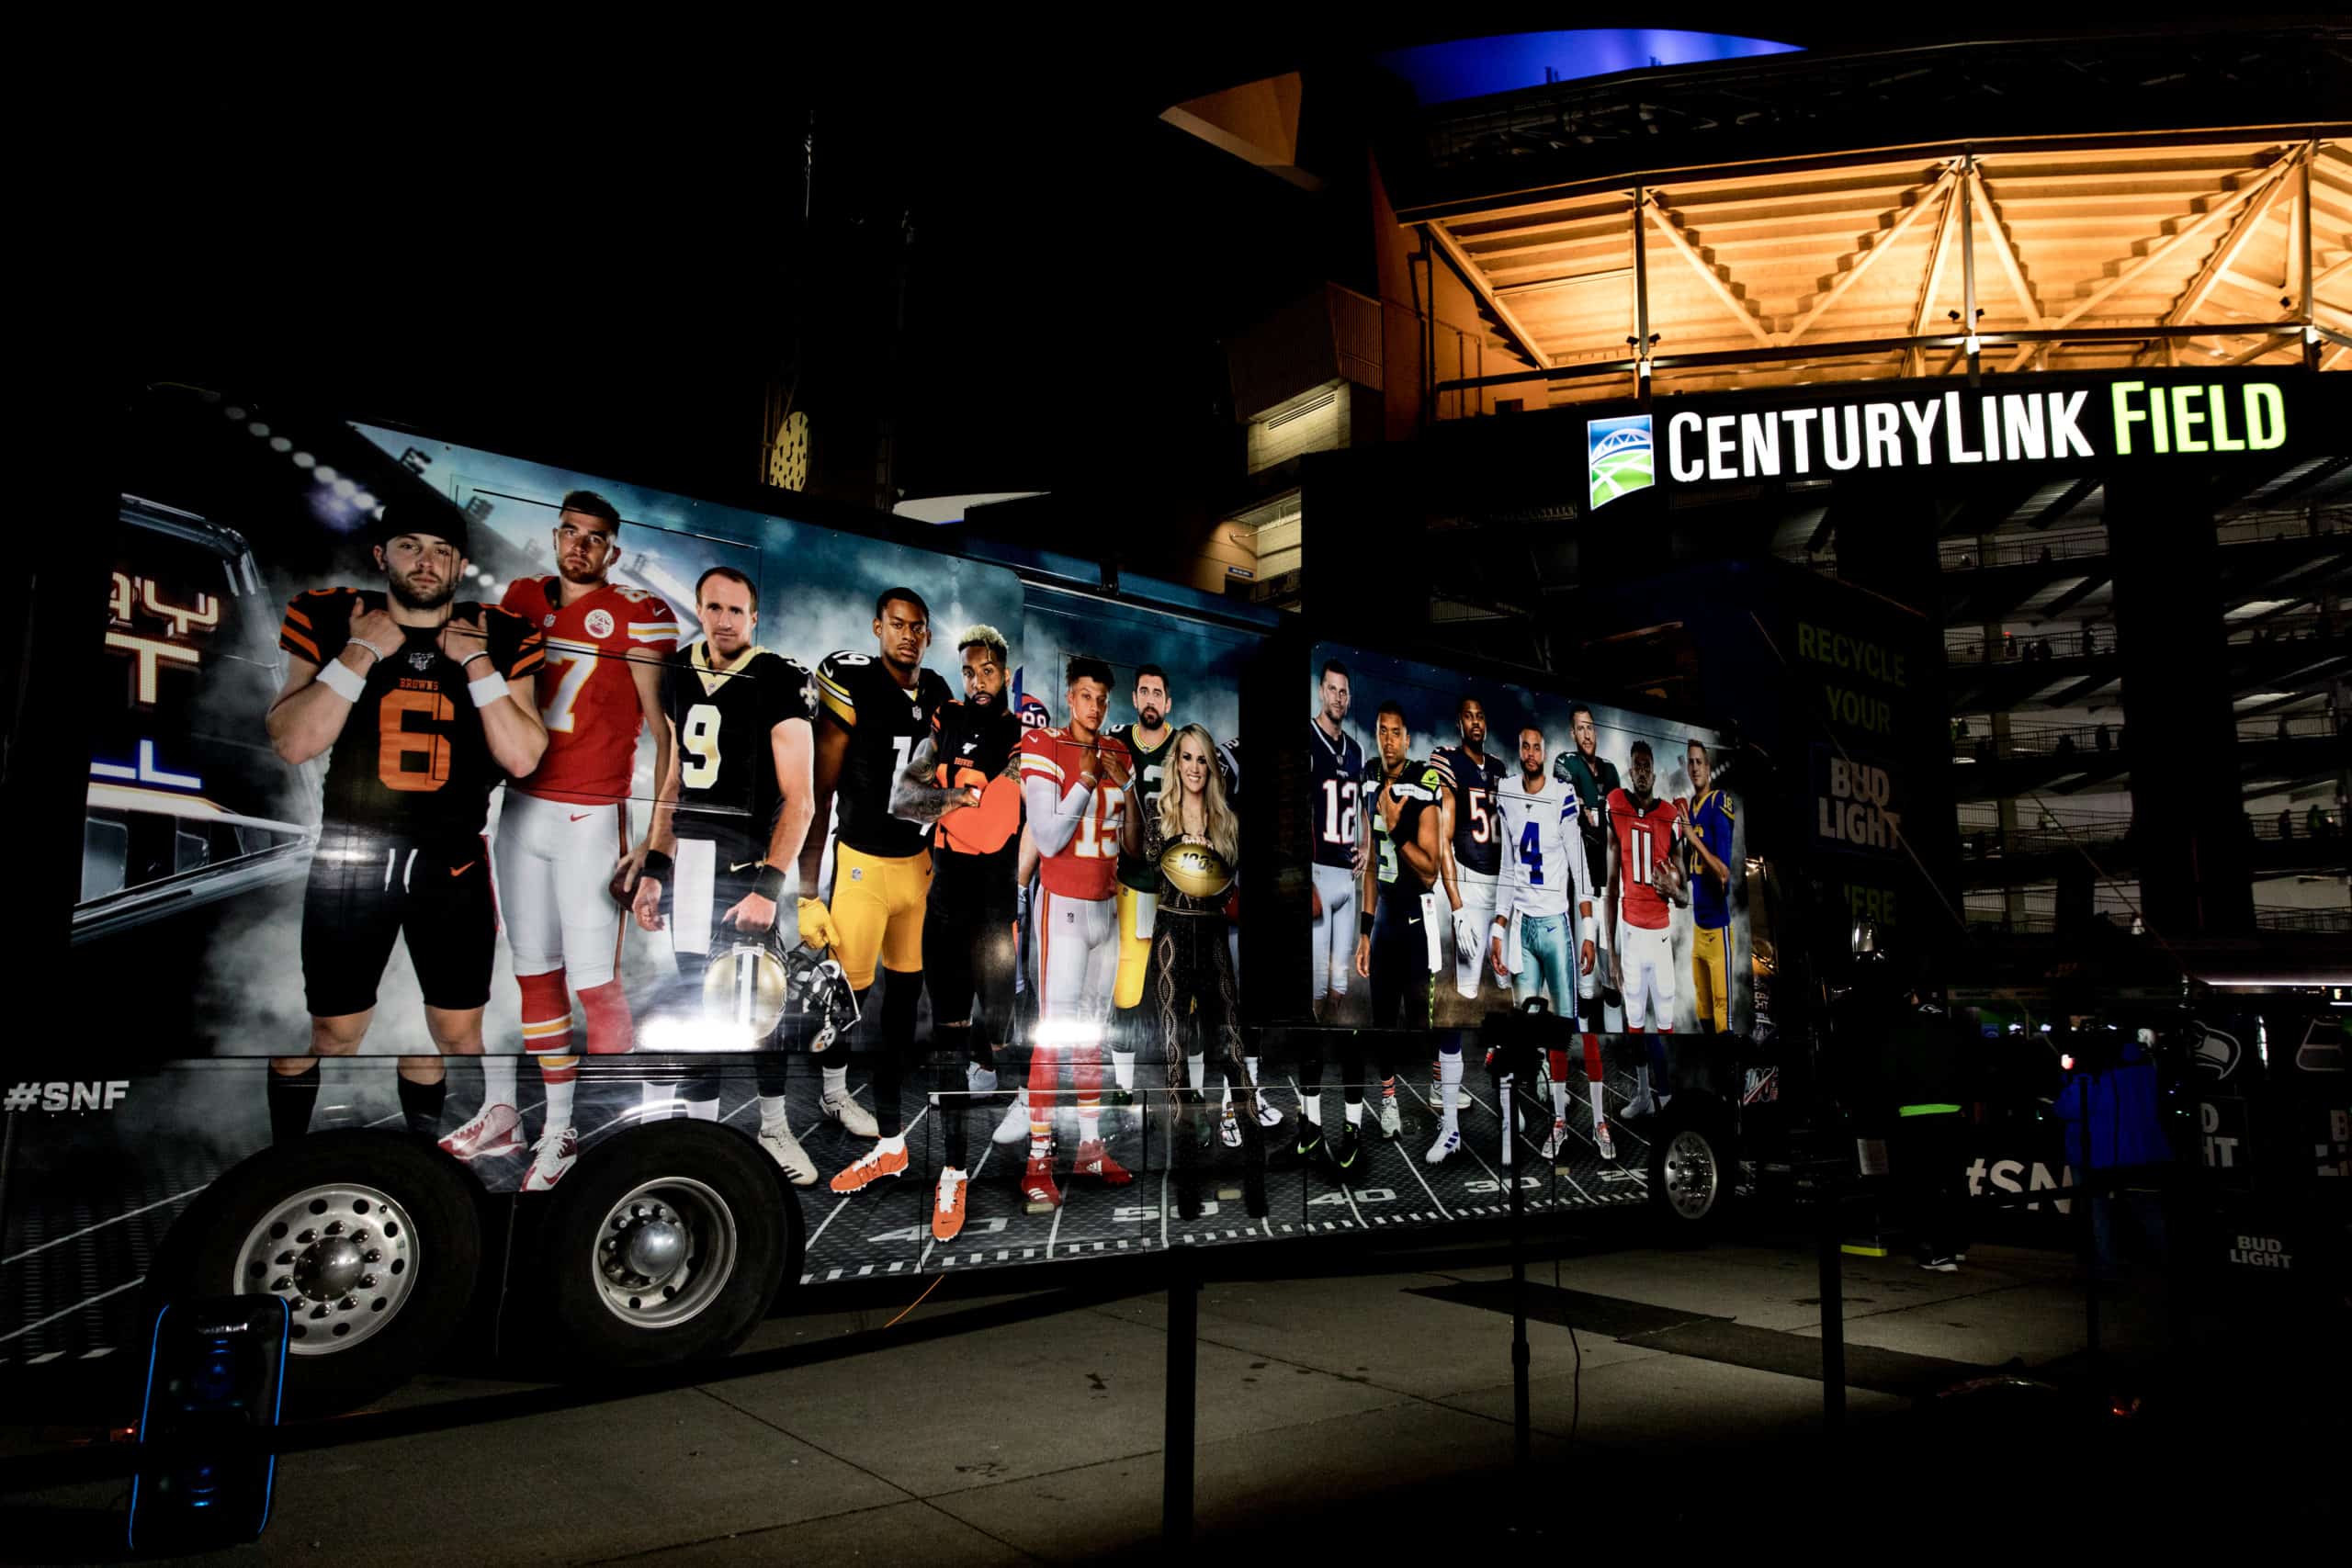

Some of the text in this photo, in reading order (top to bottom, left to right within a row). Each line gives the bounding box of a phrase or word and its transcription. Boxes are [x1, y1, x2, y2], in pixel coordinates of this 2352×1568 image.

[1668, 380, 2288, 483] CENTURYLINK FIELD
[1795, 619, 1907, 690] RECYCLE
[399, 677, 439, 691] BROWNS
[1823, 684, 1891, 736] YOUR
[378, 688, 456, 793] 6
[681, 704, 722, 790] 9
[1829, 755, 1891, 807] BUD
[1072, 784, 1127, 859] 15
[1322, 778, 1358, 846] 12
[1817, 795, 1902, 851] LIGHT
[1520, 821, 1544, 885] 4
[1631, 828, 1655, 885] 11
[2, 1079, 130, 1112] #SNF
[2229, 1248, 2293, 1270] LIGHT
[2235, 1234, 2283, 1254] BUD
